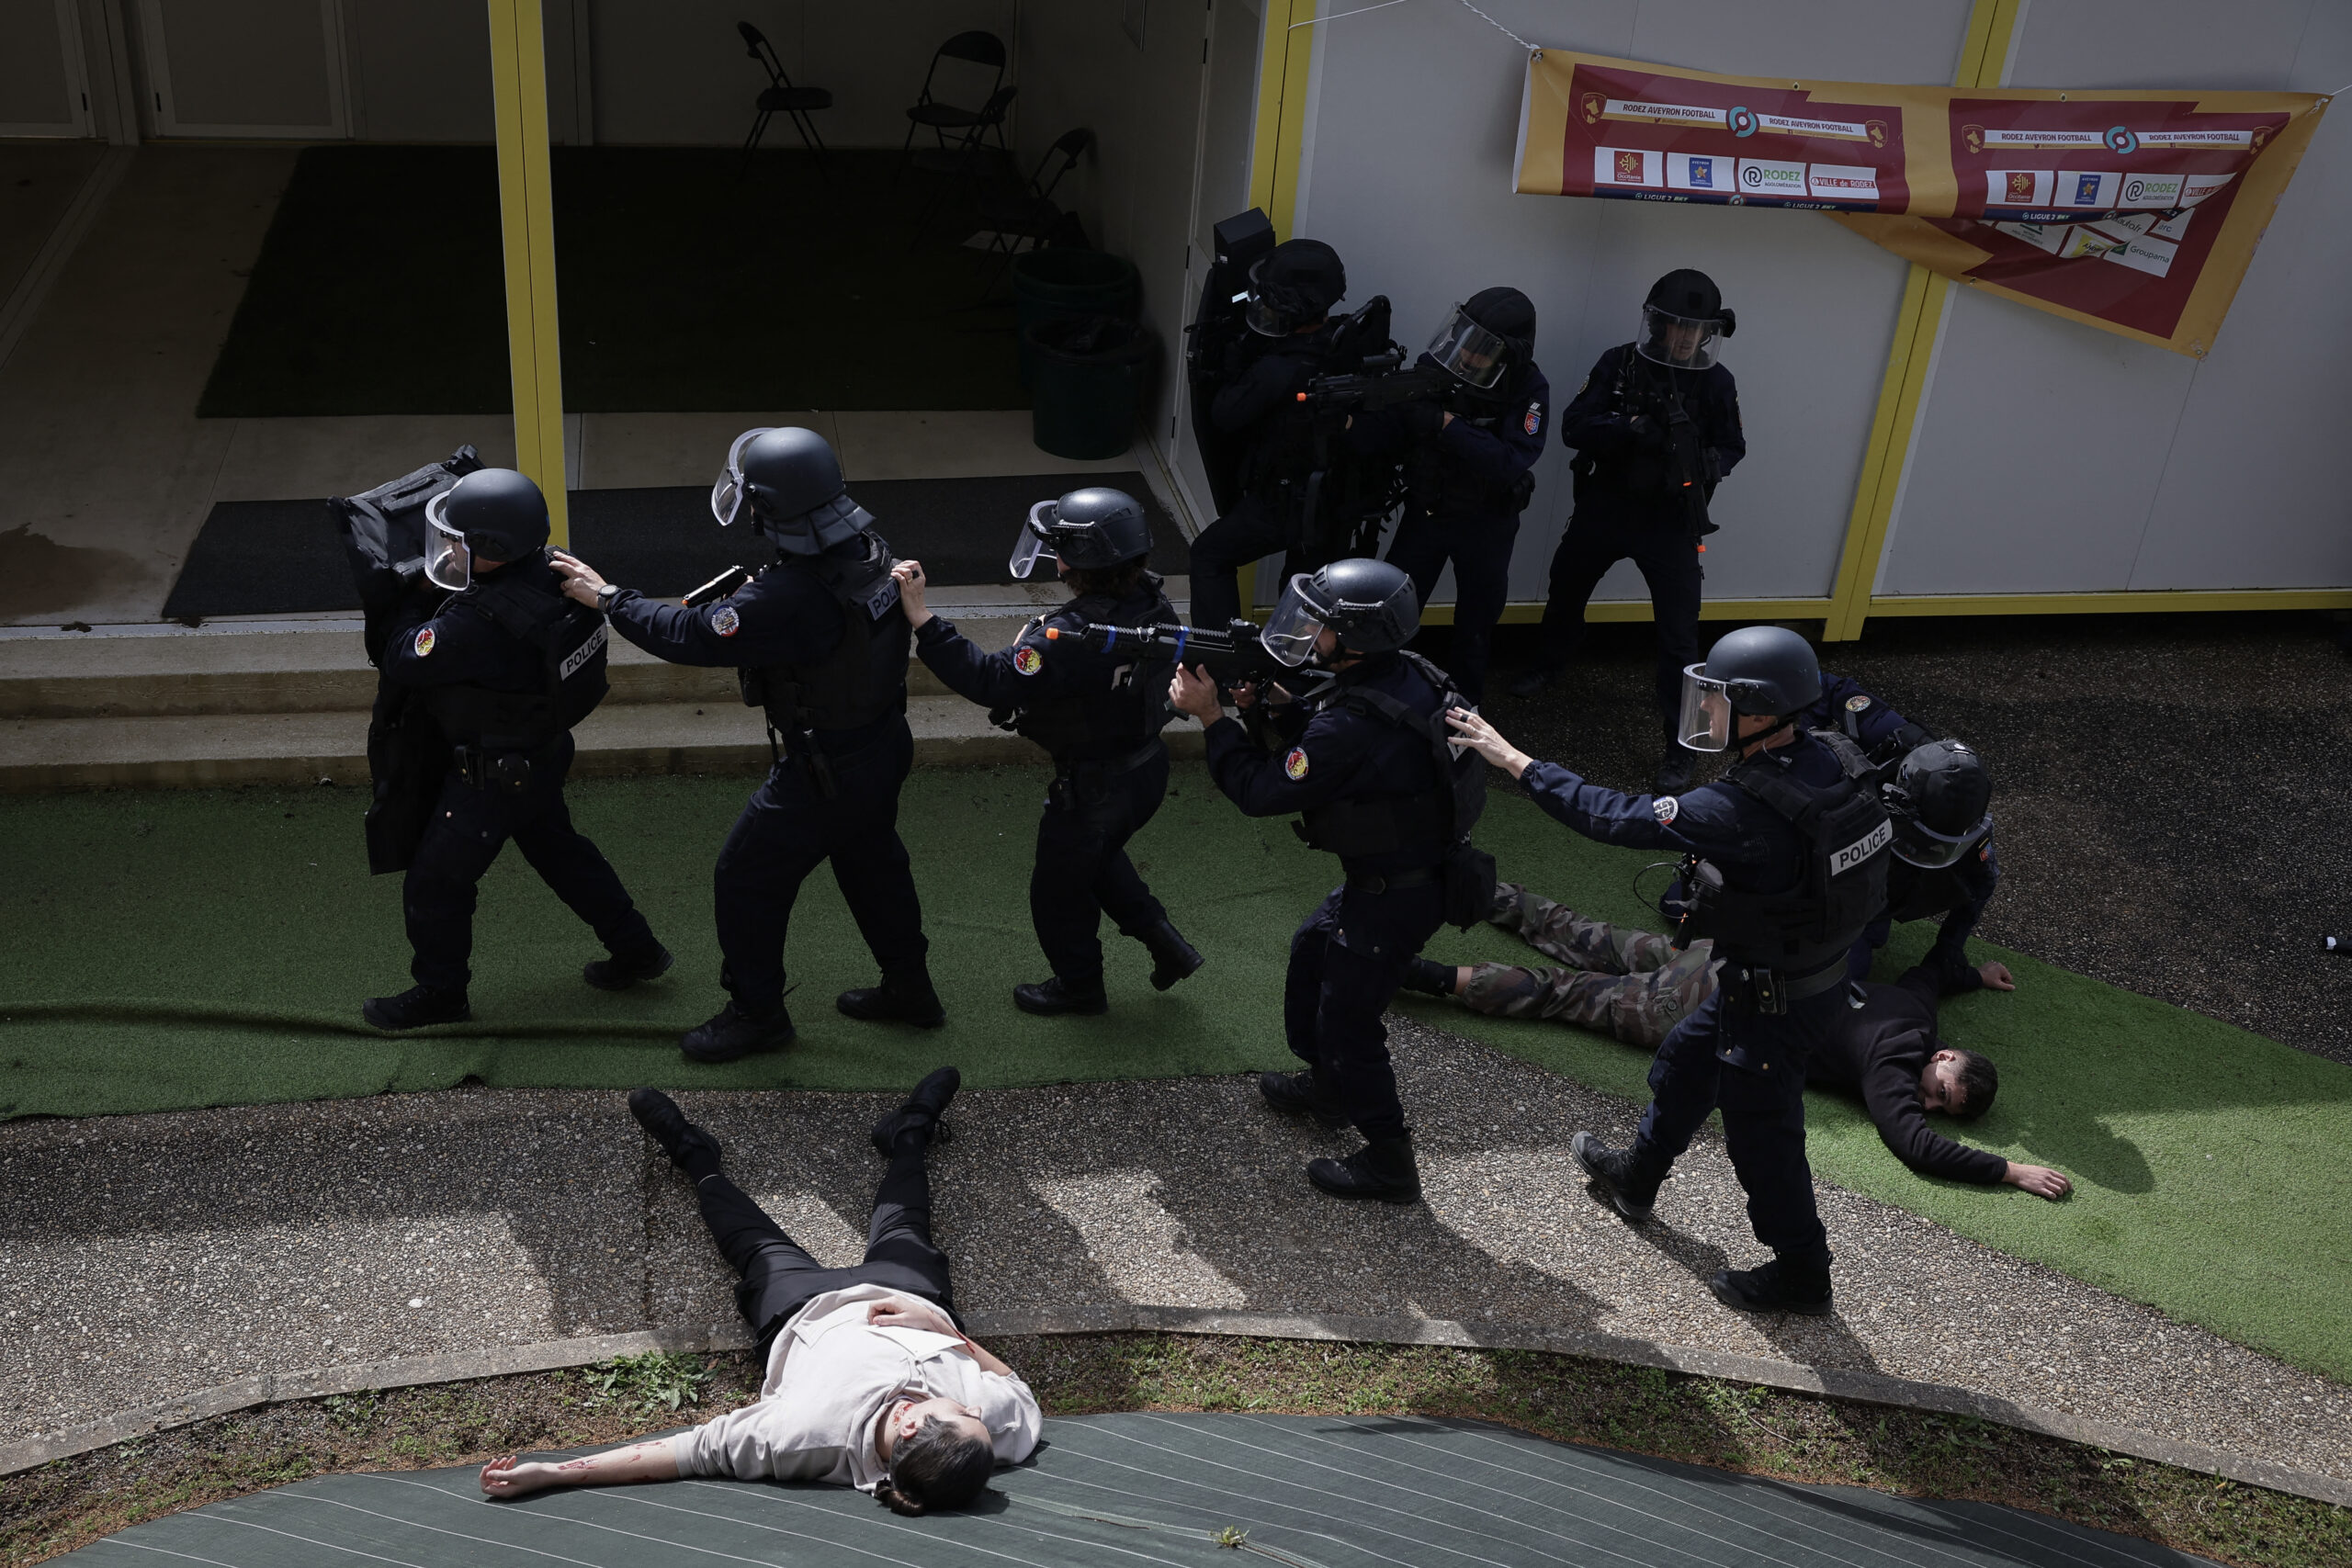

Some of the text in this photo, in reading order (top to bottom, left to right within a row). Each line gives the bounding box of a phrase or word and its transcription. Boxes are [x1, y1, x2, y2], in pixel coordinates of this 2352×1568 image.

[1623, 104, 1715, 118] RODEZ AVEYRON FOOTBALL
[1769, 118, 1854, 132] RODEZ AVEYRON FOOTBALL
[2024, 133, 2056, 141] AVEYRON
[2057, 133, 2092, 141] FOOTBALL
[1763, 169, 1801, 182] RODEZ
[1819, 177, 1838, 186] VILLE
[1850, 180, 1873, 188] RODEZ
[2144, 183, 2178, 193] RODEZ
[2130, 245, 2170, 264] Groupama
[872, 582, 899, 615] POLI
[566, 629, 603, 672] POLICE
[1839, 826, 1886, 868] POLICE
